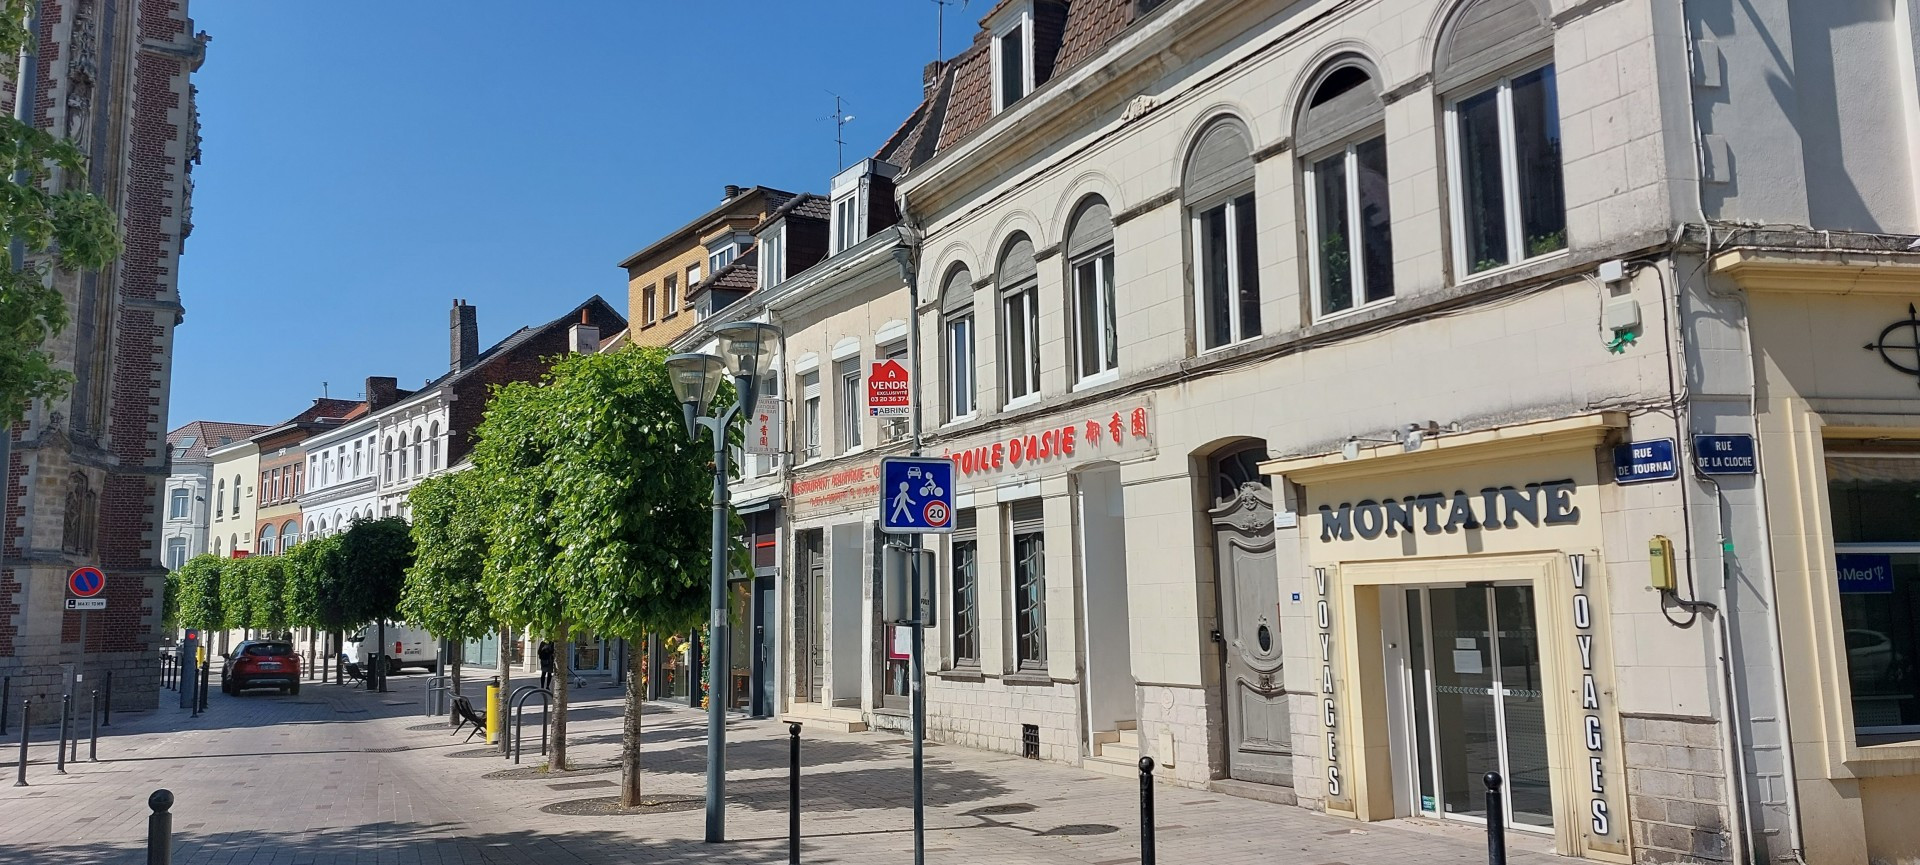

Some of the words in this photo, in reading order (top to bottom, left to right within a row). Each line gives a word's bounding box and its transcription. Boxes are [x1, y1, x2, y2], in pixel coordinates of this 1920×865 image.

[888, 370, 896, 378] A
[871, 381, 908, 389] VENDR
[943, 442, 1002, 475] TOILE
[1009, 426, 1076, 464] D'ASIE
[1716, 441, 1732, 451] RUE
[1633, 448, 1652, 459] RUE
[1700, 457, 1709, 467] DE
[1712, 457, 1722, 467] LA
[1724, 456, 1753, 467] CLOCHE
[1618, 466, 1629, 475] DE
[1632, 461, 1672, 474] TOURNAI
[930, 509, 944, 519] 20
[1319, 478, 1580, 543] MONTAINE
[1314, 567, 1340, 796] VOYAGES
[1569, 553, 1609, 837] VOYAGES
